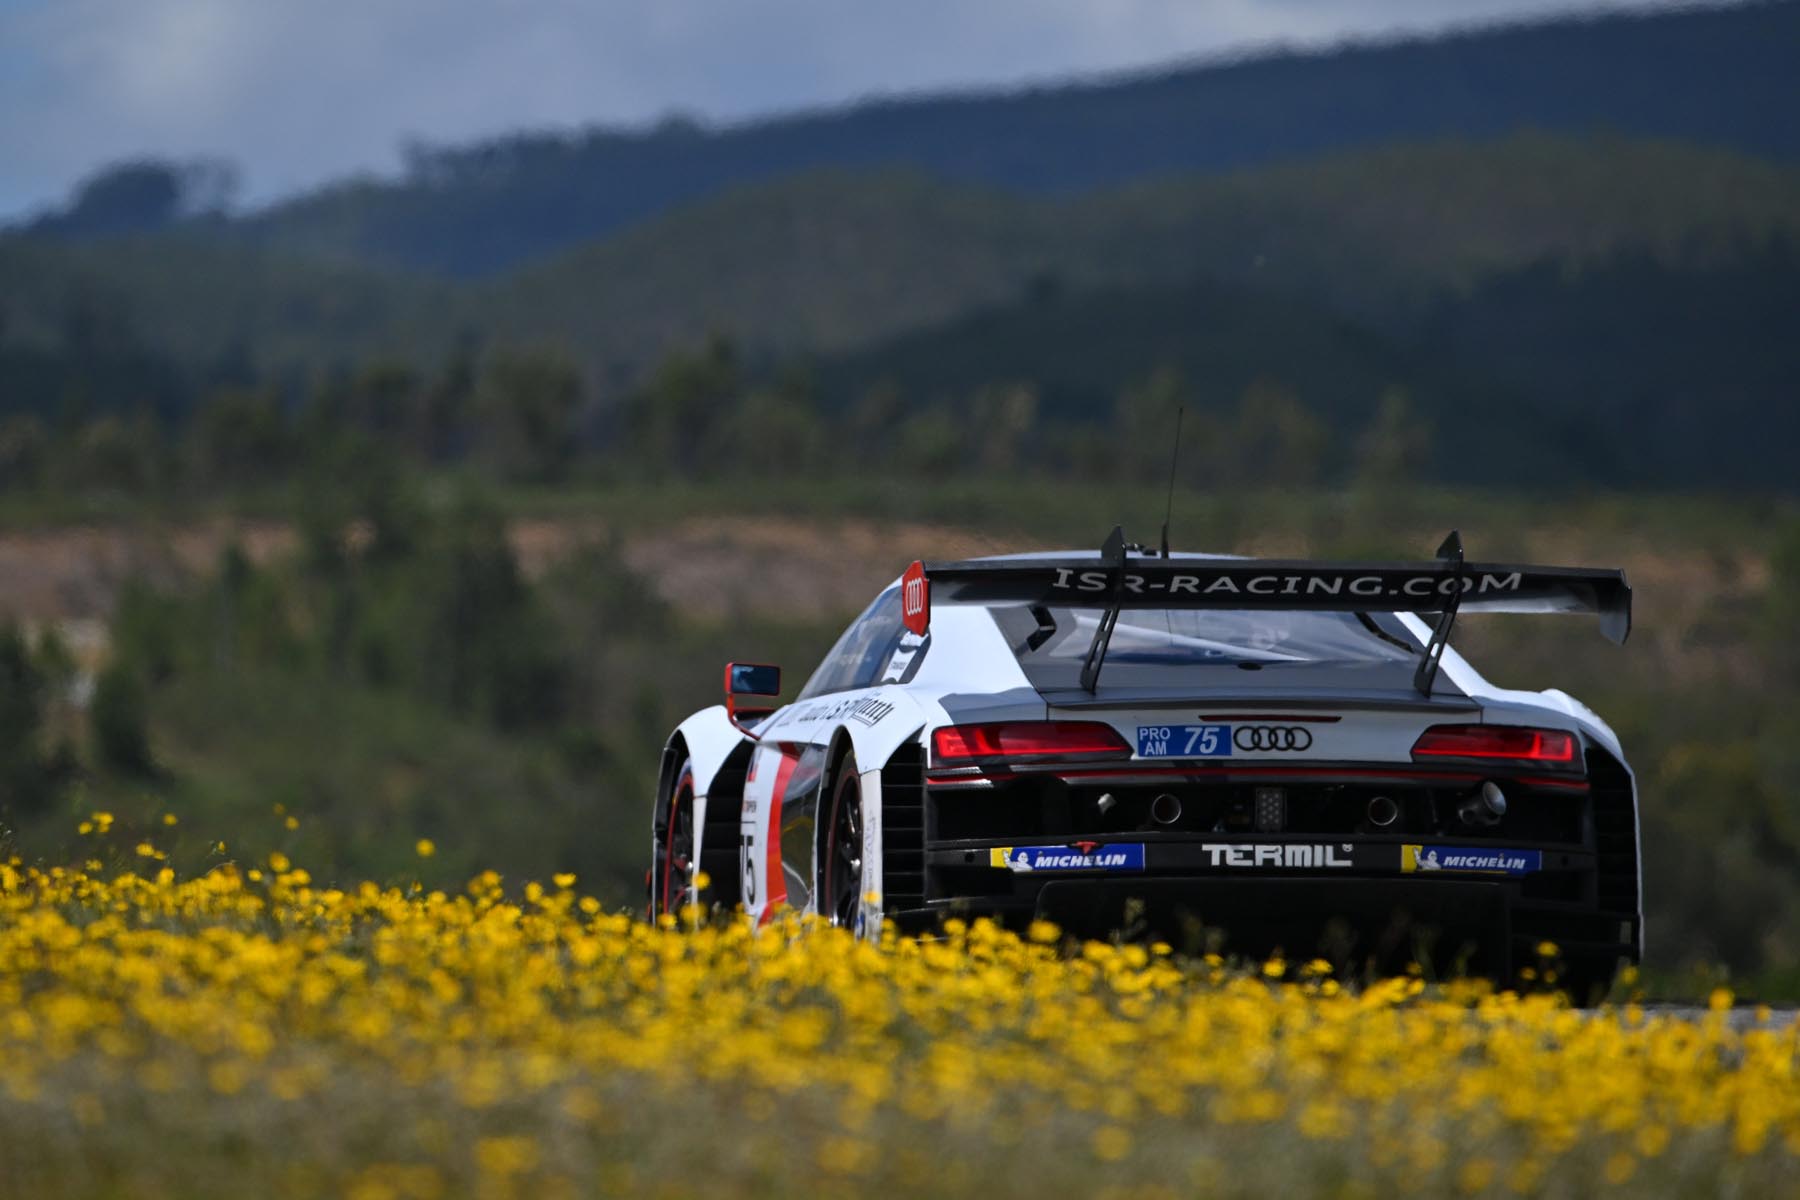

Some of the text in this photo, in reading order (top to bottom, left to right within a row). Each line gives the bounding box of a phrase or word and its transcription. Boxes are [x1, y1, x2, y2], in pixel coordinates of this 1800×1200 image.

[1053, 568, 1522, 596] ISR-RACING.COM
[1139, 727, 1171, 741] PRO
[1184, 727, 1220, 755] 75
[1144, 741, 1167, 755] AM
[1034, 853, 1127, 868] MICHELIN
[1443, 855, 1526, 870] MICHELIN
